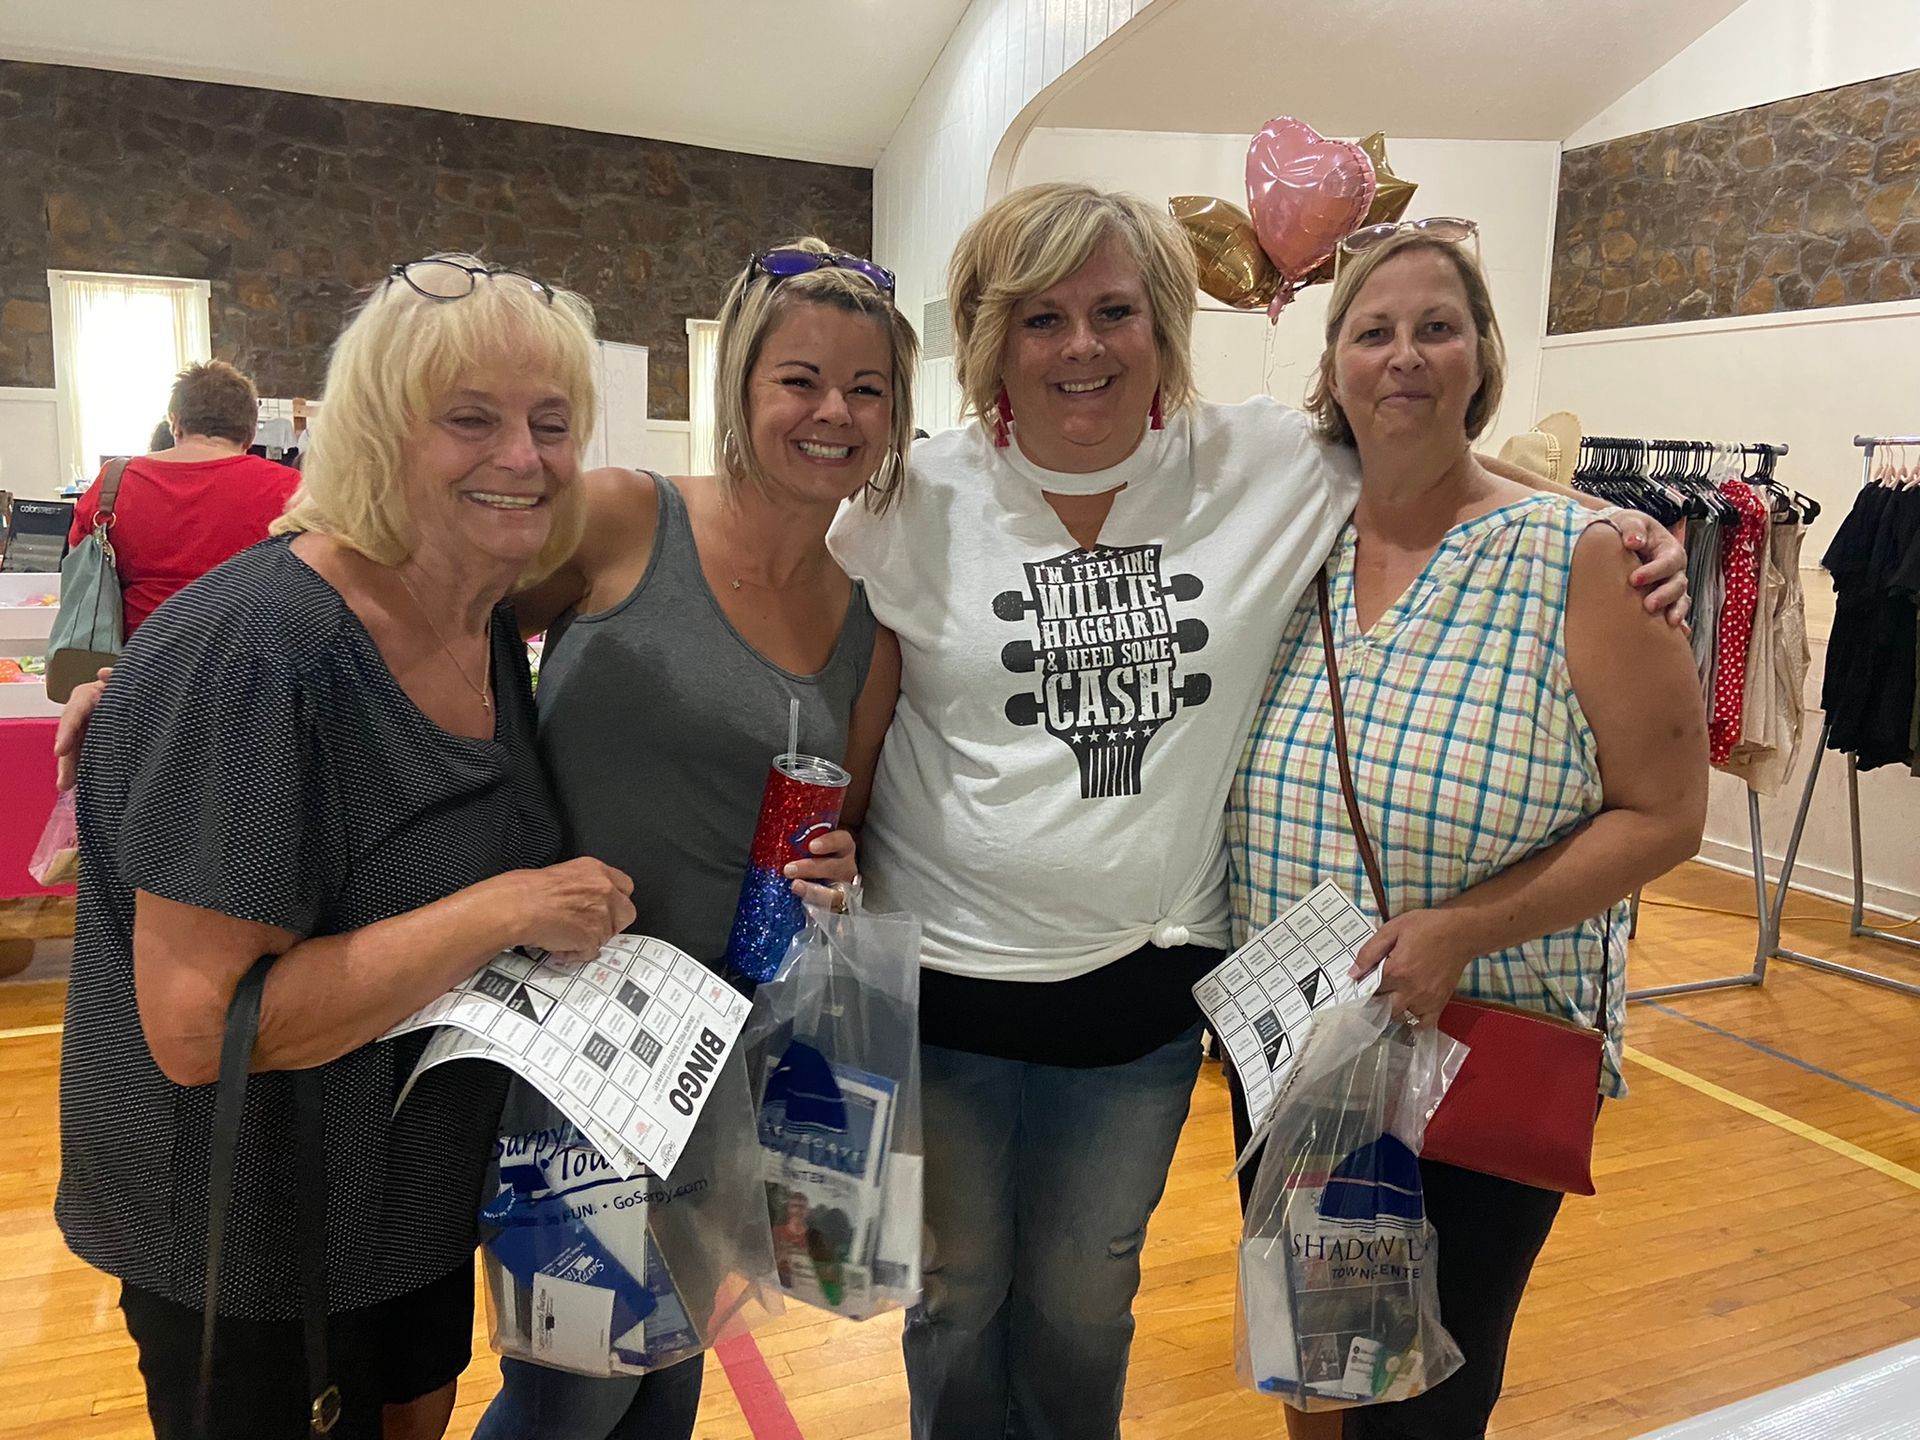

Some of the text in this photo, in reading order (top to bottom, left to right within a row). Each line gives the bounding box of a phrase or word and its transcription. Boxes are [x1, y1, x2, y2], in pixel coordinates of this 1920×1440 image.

[1033, 549, 1155, 584] I'M FEELING
[1036, 574, 1163, 620] WILLIE
[1041, 608, 1168, 649] HAGGARD
[1047, 638, 1171, 672] & NEED SOME
[1046, 661, 1173, 731] CASH
[669, 1026, 726, 1116] BINGO
[557, 1145, 614, 1181] Tou
[613, 1179, 709, 1210] GoSarpy.com
